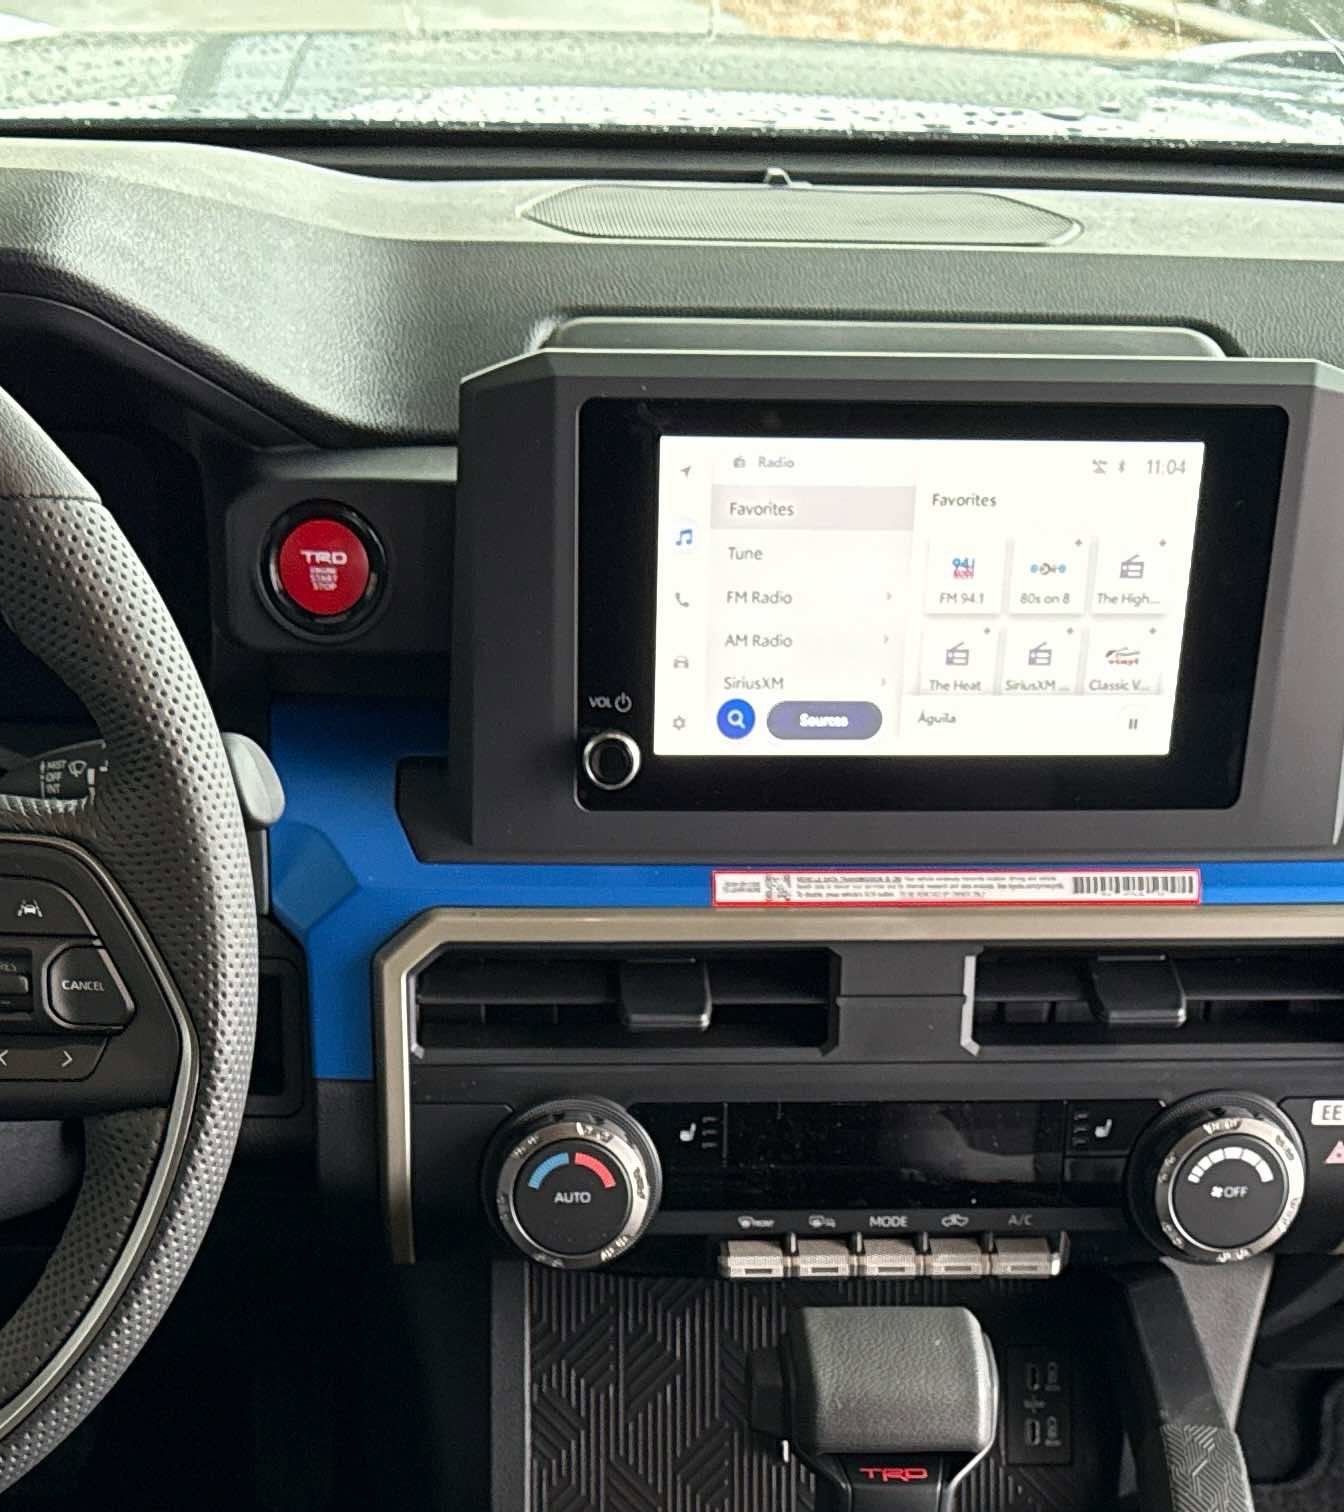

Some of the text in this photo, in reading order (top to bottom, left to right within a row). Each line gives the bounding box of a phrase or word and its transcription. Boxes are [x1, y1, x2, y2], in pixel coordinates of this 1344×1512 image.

[757, 456, 795, 469] Radio
[1146, 459, 1187, 475] 11:04
[931, 493, 998, 508] Favorites
[729, 502, 795, 517] Favorites
[299, 549, 349, 565] TRD
[728, 546, 764, 561] Tune
[726, 590, 793, 605] FM Radio
[939, 592, 958, 605] FM
[1096, 592, 1119, 604] The
[724, 634, 793, 648] AM Radio
[723, 676, 784, 690] SiriusXM
[929, 679, 983, 692] The Heat
[1088, 679, 1129, 691] Classic
[588, 695, 613, 708] VOL
[799, 713, 849, 728] Sources
[61, 979, 105, 992] CANCEL
[1321, 1104, 1343, 1121] EE
[554, 1192, 592, 1204] AUTO
[1223, 1186, 1249, 1198] OFF
[868, 1214, 908, 1228] MODE
[1007, 1213, 1034, 1226] A/C
[858, 1467, 929, 1482] TRD
